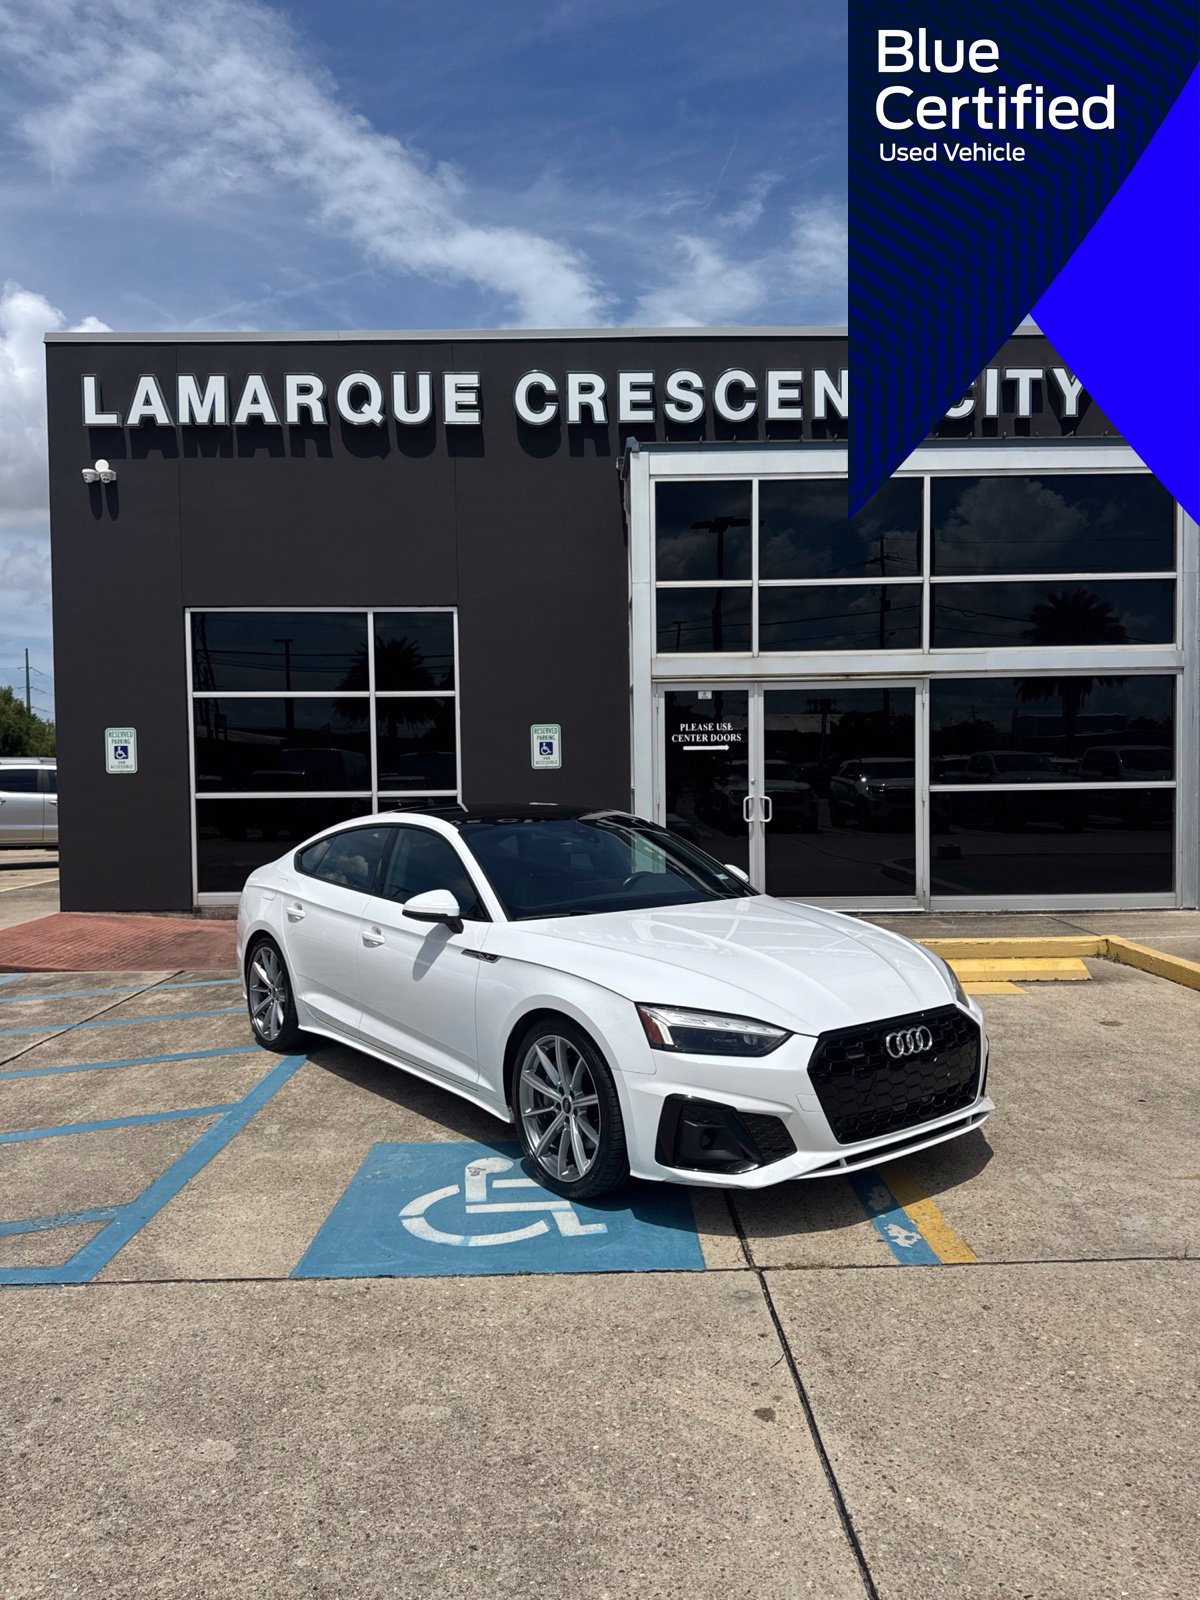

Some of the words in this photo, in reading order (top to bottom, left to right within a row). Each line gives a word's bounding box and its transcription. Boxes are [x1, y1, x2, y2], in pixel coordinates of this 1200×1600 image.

[82, 370, 481, 425] LAMARQUE
[514, 368, 848, 424] CRESCEN
[680, 722, 715, 732] PLEASE
[716, 722, 734, 731] USE
[671, 733, 709, 743] CENTER
[710, 733, 742, 742] DOORS
